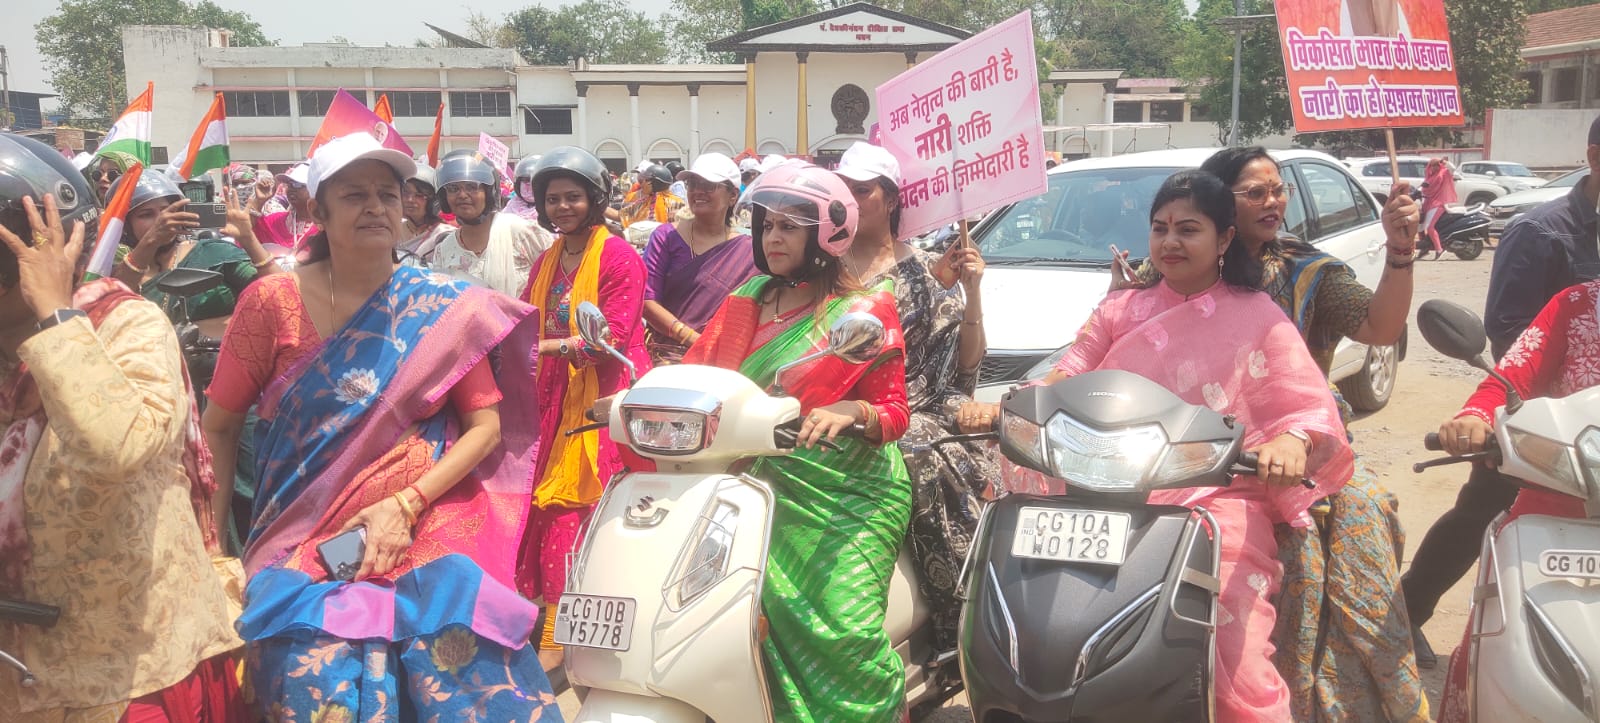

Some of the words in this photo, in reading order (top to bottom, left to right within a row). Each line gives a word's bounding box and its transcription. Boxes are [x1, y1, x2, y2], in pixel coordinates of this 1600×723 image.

[1288, 30, 1354, 69] विकसित
[1354, 39, 1392, 69] भारत
[1392, 33, 1411, 68] की
[1411, 41, 1450, 69] पहचान
[889, 104, 909, 132] अब
[911, 86, 944, 124] नेतृत्व
[946, 70, 967, 103] की
[968, 55, 999, 92] बारी
[1001, 48, 1018, 82] है,
[1302, 80, 1342, 117] नारी
[1342, 88, 1365, 115] का
[1365, 78, 1383, 116] हो
[1383, 88, 1425, 115] सशक्त
[1425, 88, 1459, 114] स्थान
[915, 112, 952, 161] नारी
[957, 110, 992, 146] शक्ति
[931, 166, 950, 198] की
[951, 141, 1015, 193] ज़िम्मेदारी
[1017, 133, 1029, 169] है
[1036, 511, 1110, 536] CG10A
[1546, 555, 1570, 572] CG
[572, 597, 626, 623] CG10B
[569, 620, 622, 646] Y5778
